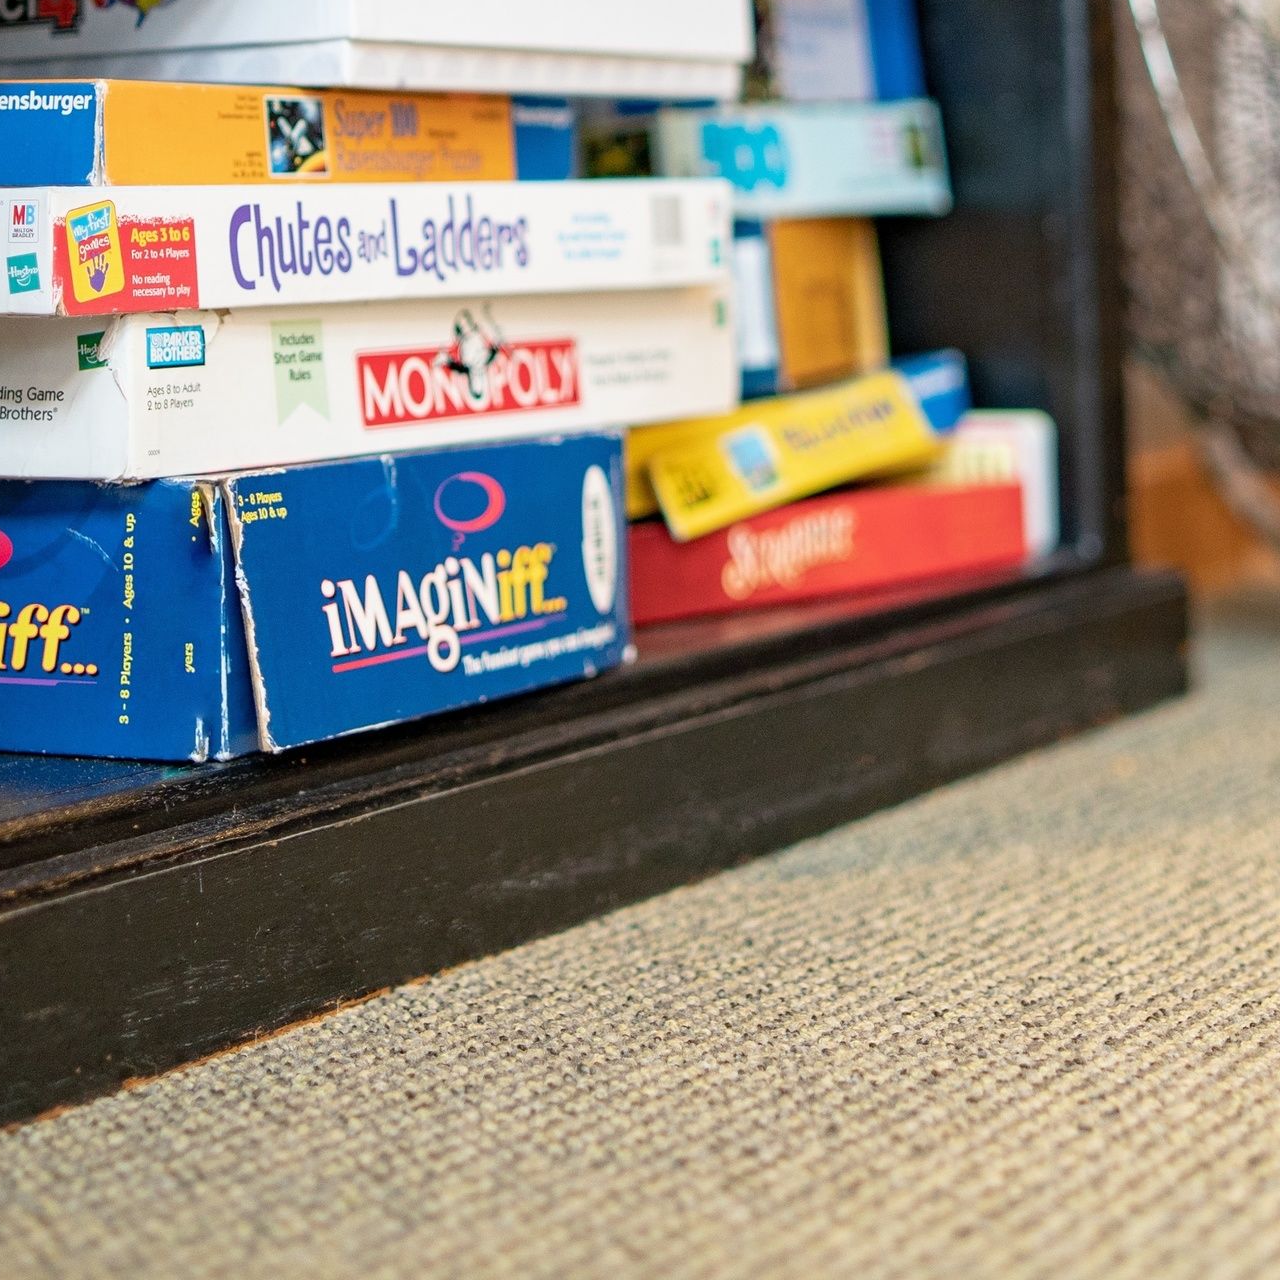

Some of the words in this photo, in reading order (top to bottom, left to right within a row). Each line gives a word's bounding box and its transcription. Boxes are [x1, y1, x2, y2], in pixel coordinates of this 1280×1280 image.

[333, 98, 387, 141] Super
[13, 204, 36, 225] MB
[73, 222, 88, 241] my
[87, 211, 111, 232] first
[131, 228, 160, 248] Ages
[160, 228, 168, 242] 3
[169, 228, 181, 241] to
[181, 227, 190, 241] 6
[229, 200, 353, 293] Chutes
[357, 219, 389, 264] and
[389, 193, 530, 282] Ladders
[79, 235, 111, 262] games
[131, 249, 143, 260] For
[144, 249, 150, 260] 2
[150, 249, 158, 259] to
[158, 249, 165, 259] 4
[166, 249, 190, 261] Players
[8, 264, 40, 277] Hasbro
[132, 275, 143, 285] No
[144, 275, 171, 286] reading
[132, 287, 167, 298] necessary
[167, 286, 176, 296] to
[176, 286, 191, 298] play
[161, 328, 202, 347] PARKER
[279, 333, 315, 347] Includes
[150, 345, 203, 363] BROTHERS
[274, 350, 297, 365] Short
[298, 349, 322, 363] Game
[289, 369, 312, 382] Rules
[363, 344, 576, 422] MONOPOLY
[26, 387, 65, 402] Game
[147, 384, 163, 397] Ages
[165, 384, 172, 395] 8
[173, 384, 181, 394] to
[182, 382, 202, 394] Adult
[0, 406, 53, 421] Brothers
[147, 401, 153, 412] 2
[154, 400, 163, 410] to
[163, 399, 169, 410] 8
[170, 398, 195, 410] Players
[238, 496, 244, 506] 3
[250, 495, 256, 505] 8
[257, 492, 283, 505] Players
[189, 491, 202, 527] Ages
[240, 512, 259, 525] Ages
[259, 509, 269, 520] 10
[269, 508, 277, 519] &
[276, 507, 288, 519] up
[126, 513, 137, 532] up
[123, 535, 134, 548] &
[123, 553, 134, 570] 10
[123, 575, 135, 609] Ages
[121, 632, 133, 685] Players
[185, 643, 196, 673] yers
[462, 654, 483, 677] The
[120, 689, 131, 699] 8
[119, 715, 130, 725] 3
